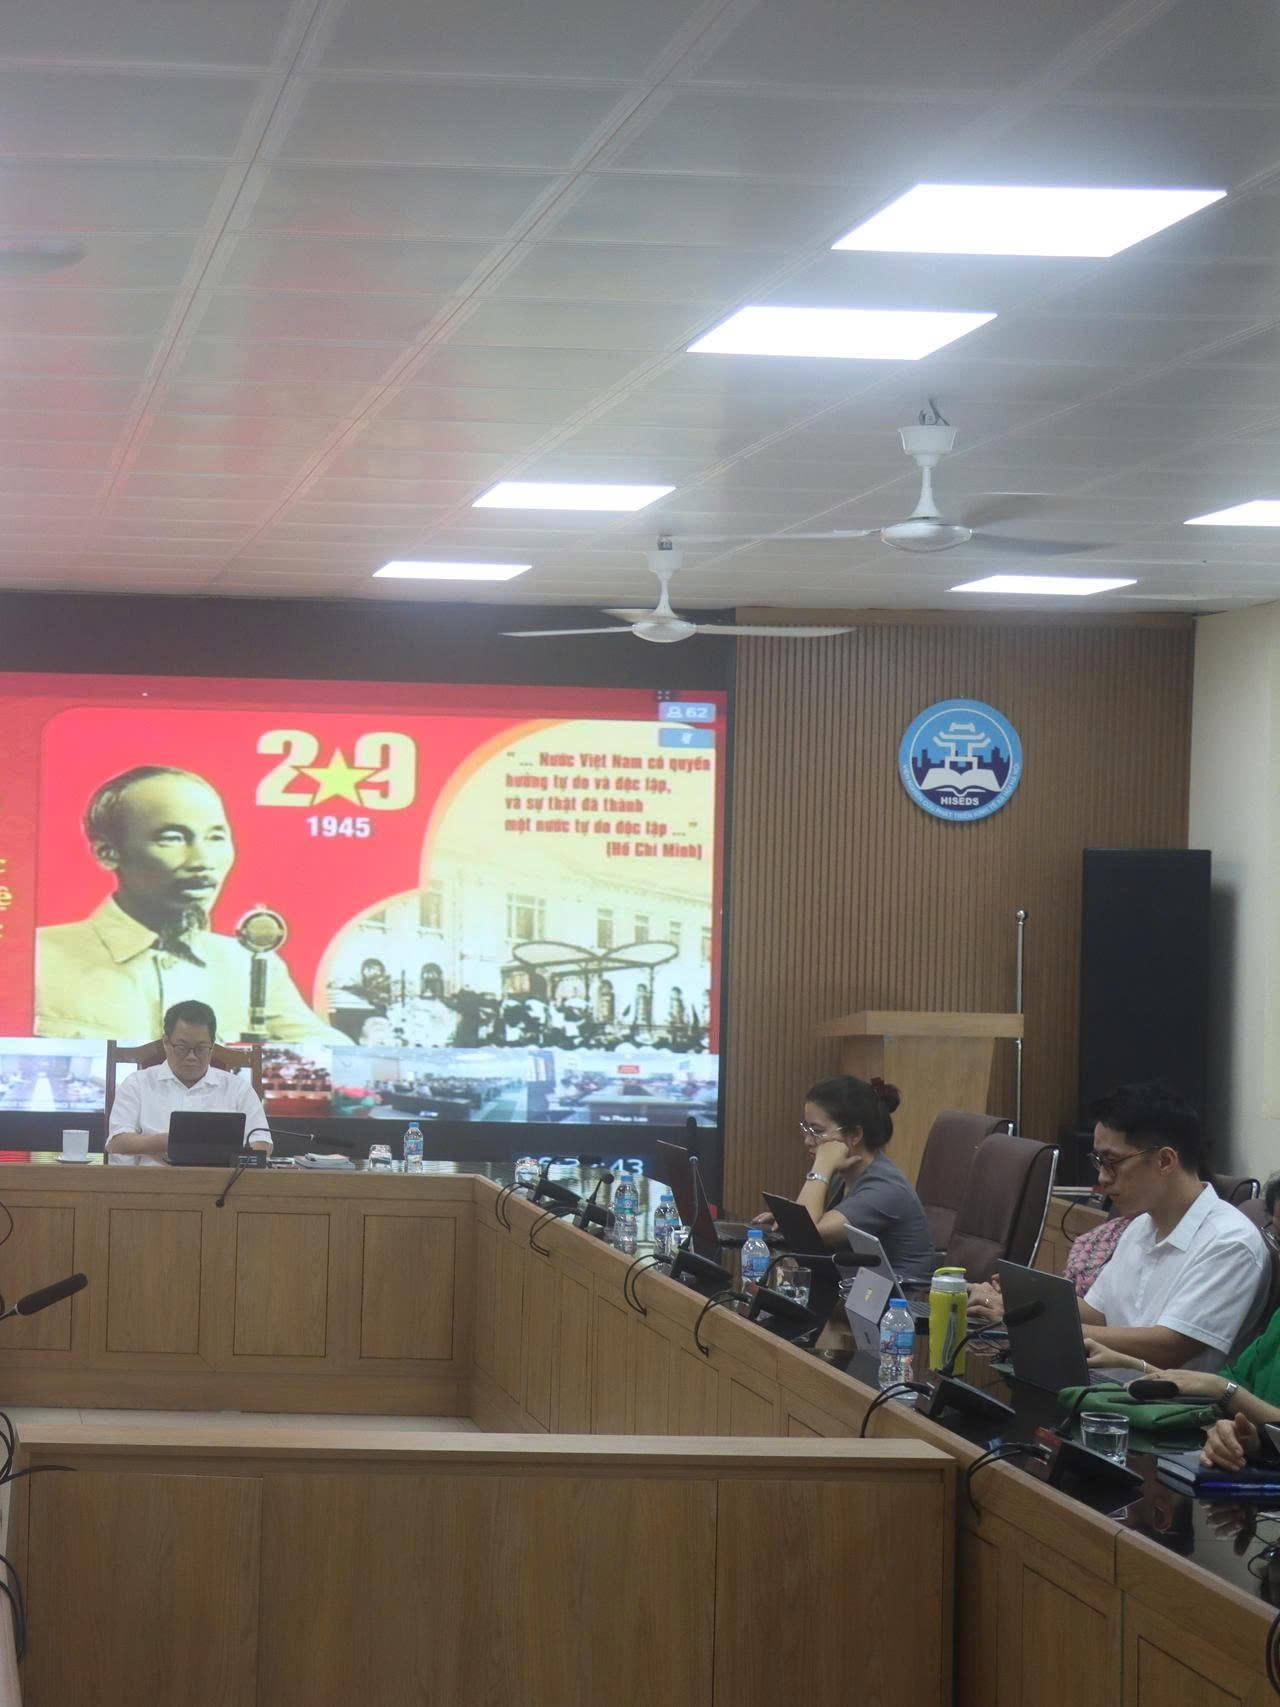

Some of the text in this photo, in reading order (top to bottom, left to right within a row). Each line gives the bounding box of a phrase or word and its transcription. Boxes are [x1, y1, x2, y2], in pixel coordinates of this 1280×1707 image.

[685, 706, 708, 719] 62
[580, 753, 607, 770] Việt
[612, 755, 642, 768] Nam
[648, 756, 664, 769] có
[554, 775, 567, 791] tự
[573, 777, 589, 789] do
[595, 777, 609, 789] và
[615, 777, 640, 793] độc
[505, 797, 521, 809] và
[526, 798, 543, 813] sự
[548, 797, 576, 813] thật
[604, 799, 643, 812] thành
[941, 797, 979, 805] HISEDS
[307, 817, 370, 838] 1945
[505, 818, 530, 835] một
[575, 820, 589, 835] tự
[594, 822, 610, 834] do
[616, 822, 640, 836] độc
